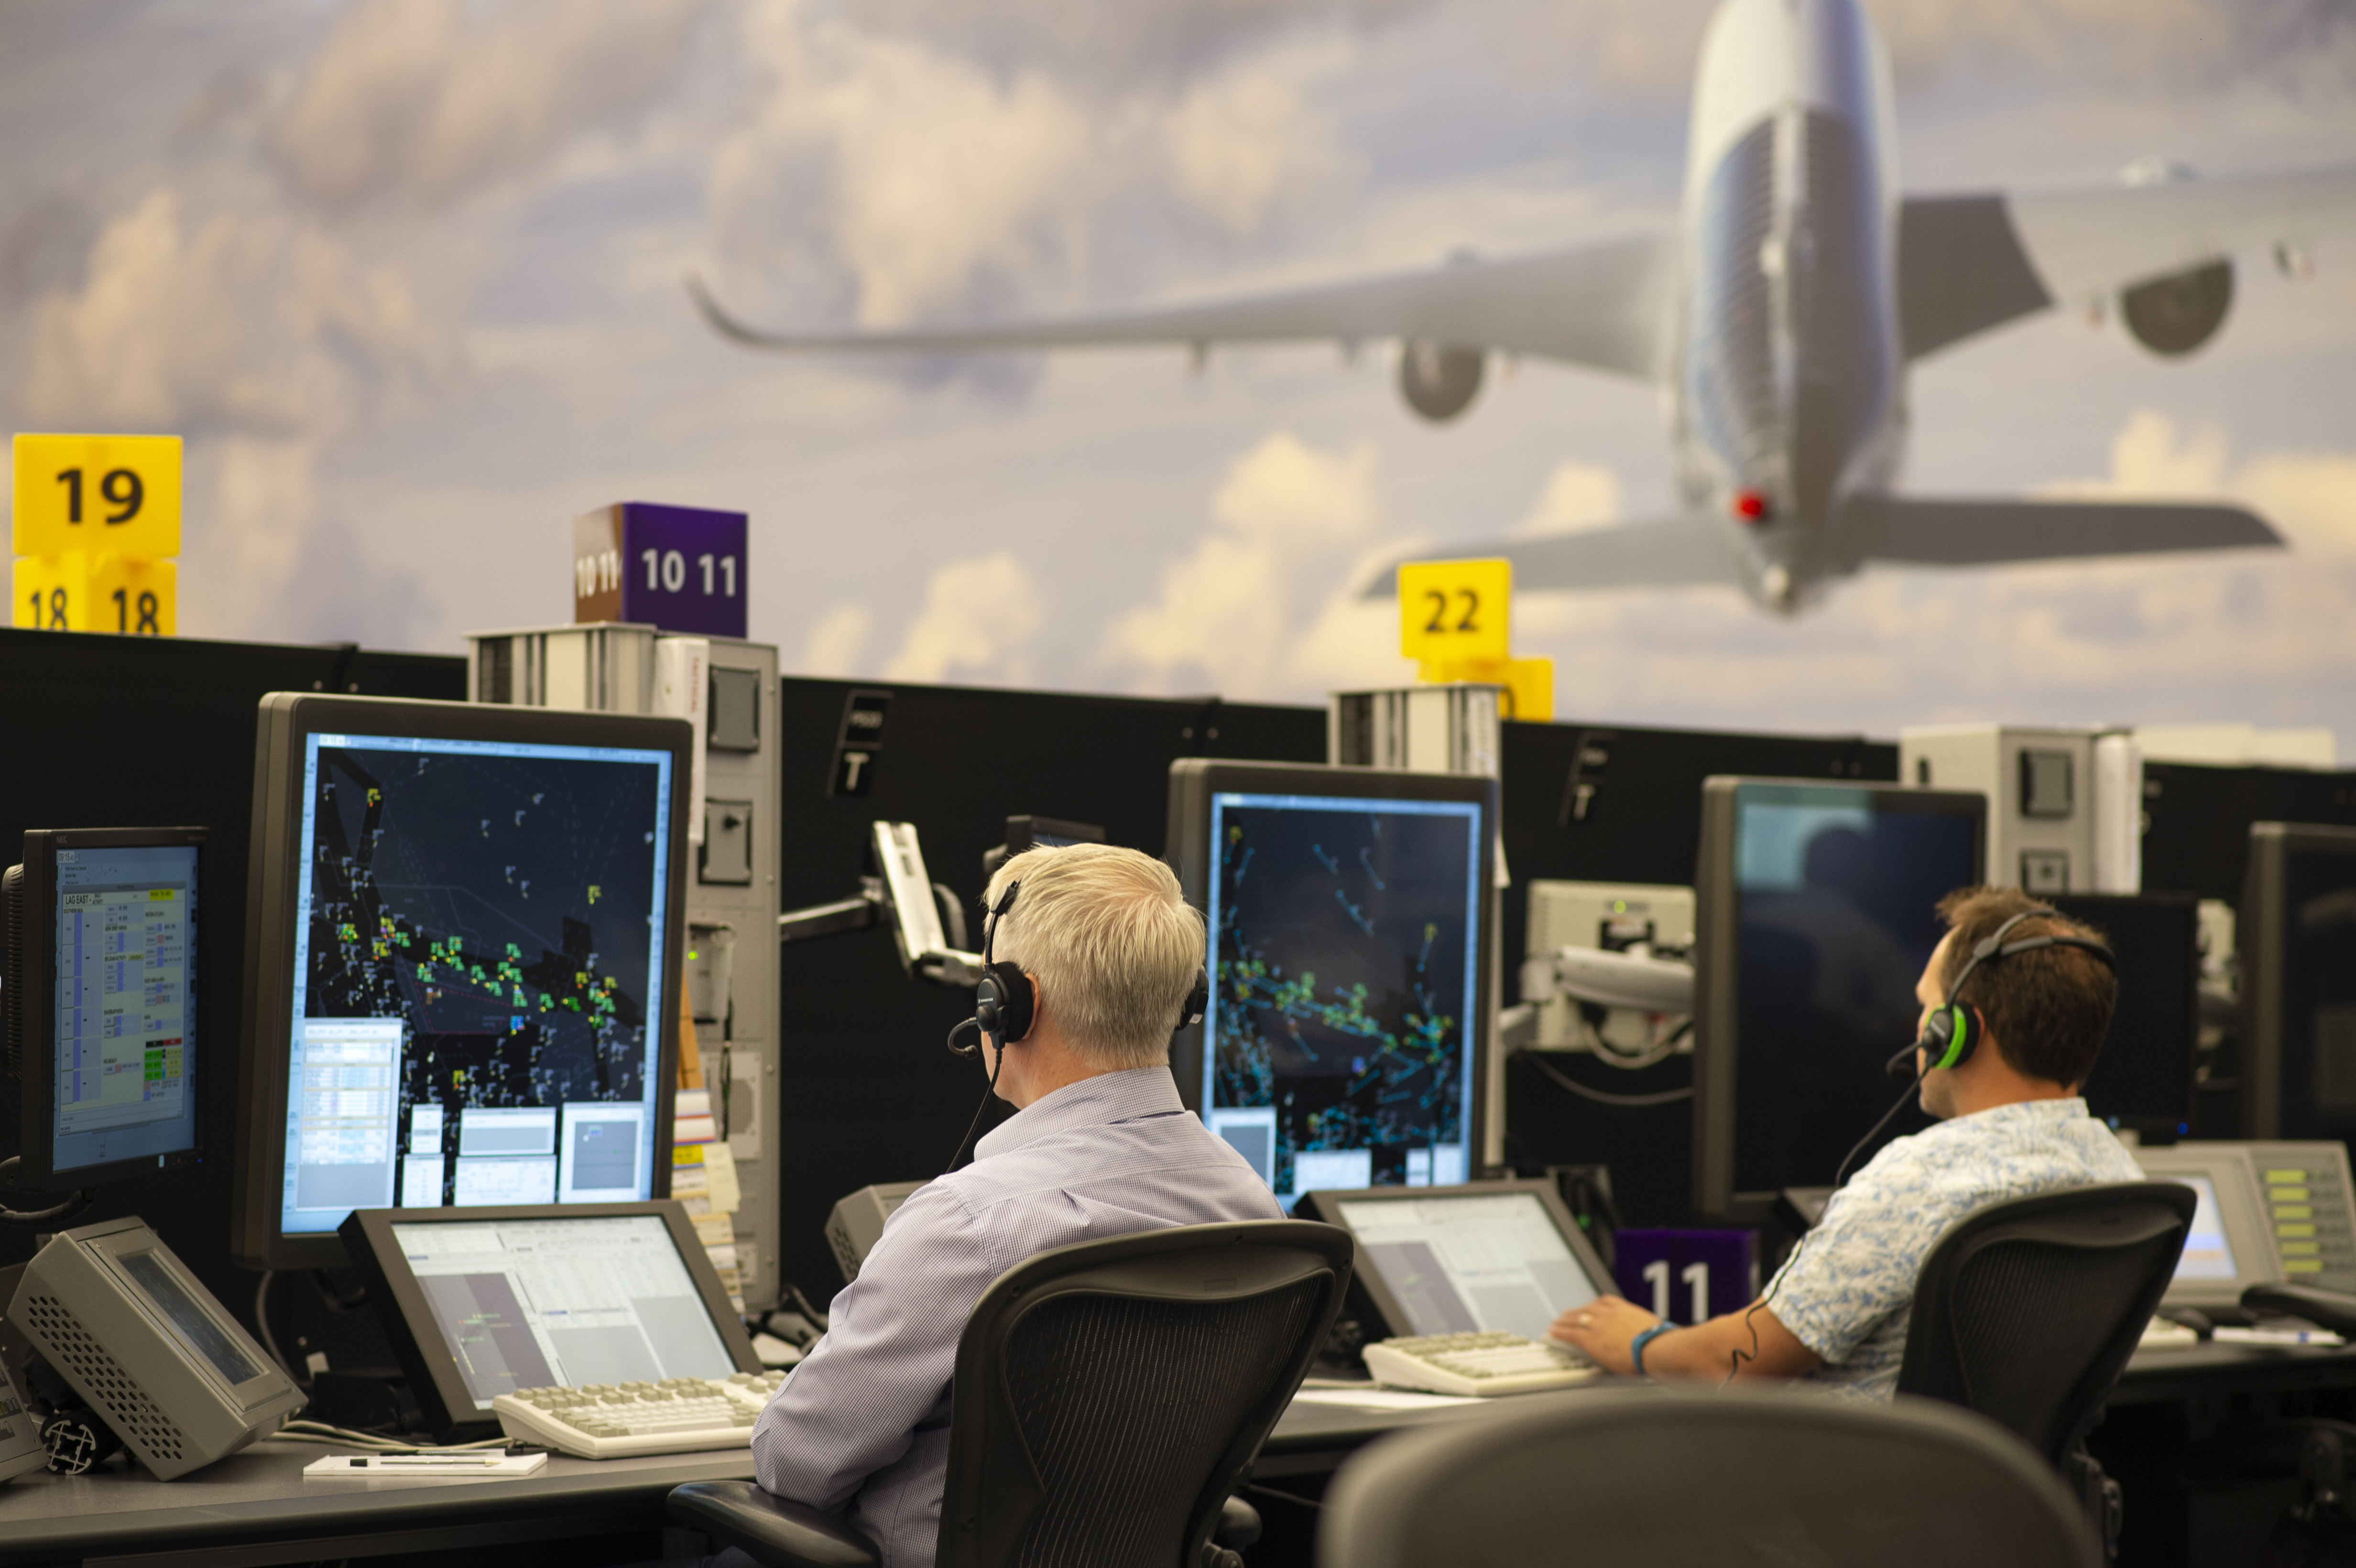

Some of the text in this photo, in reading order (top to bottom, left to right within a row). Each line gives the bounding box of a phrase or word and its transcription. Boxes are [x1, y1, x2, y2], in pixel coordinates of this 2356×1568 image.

[56, 468, 145, 525] 19
[575, 549, 619, 599] 10 11
[641, 548, 736, 598] 10 11
[30, 587, 68, 630] 18
[112, 588, 159, 636] 18
[1423, 588, 1481, 633] 22
[56, 835, 67, 843] NEC
[65, 895, 76, 904] LAG
[76, 895, 88, 904] EAST
[1641, 1259, 1709, 1325] 11
